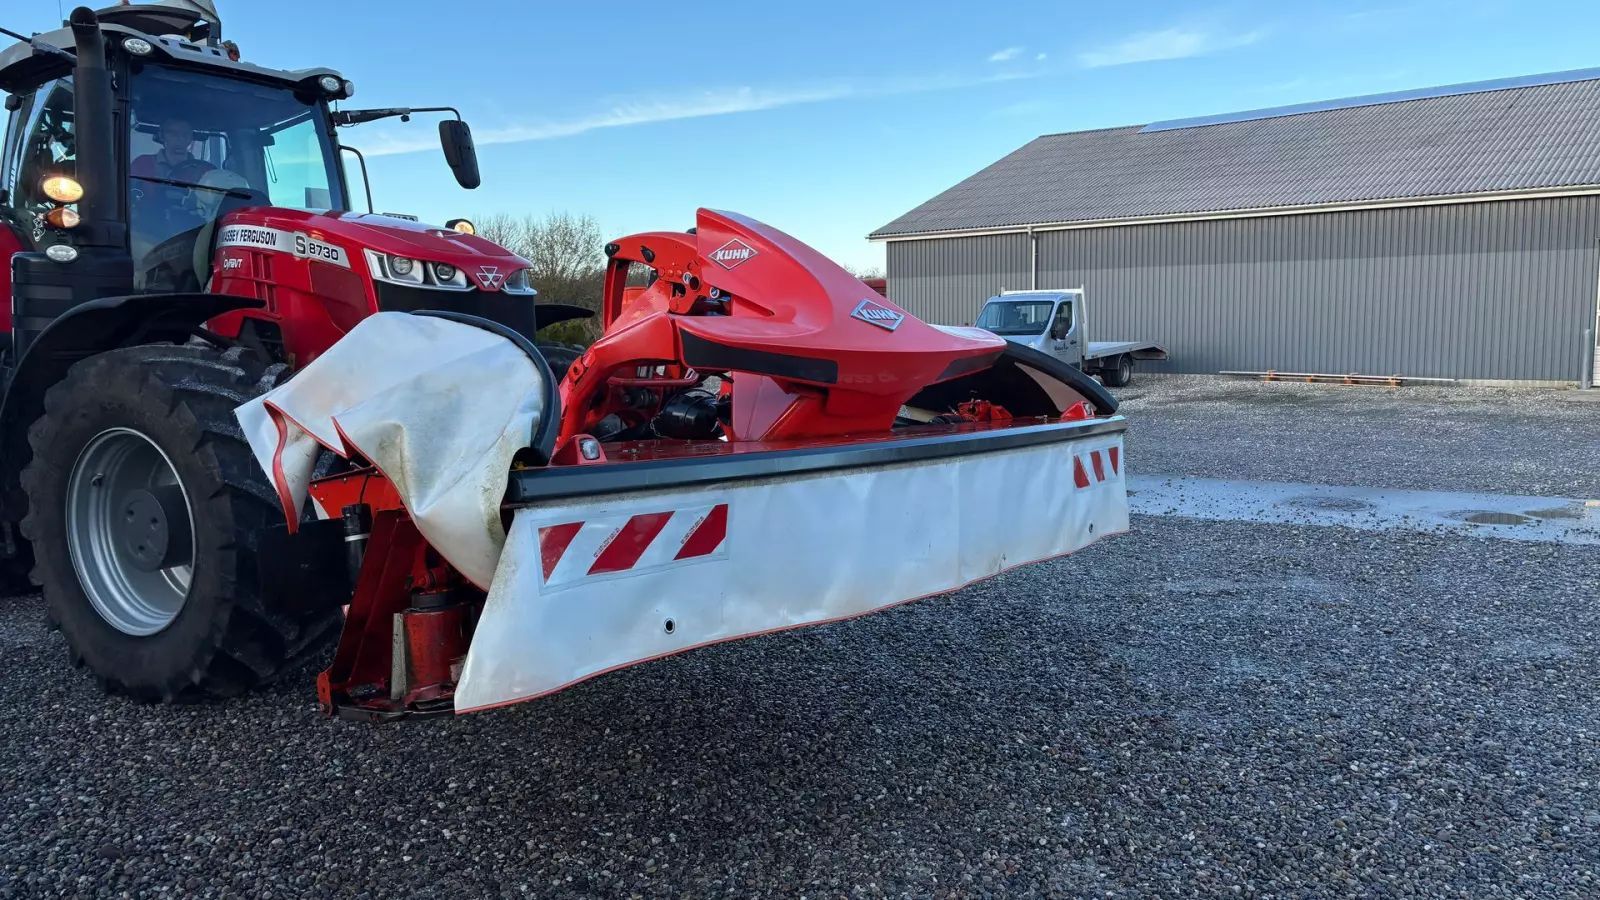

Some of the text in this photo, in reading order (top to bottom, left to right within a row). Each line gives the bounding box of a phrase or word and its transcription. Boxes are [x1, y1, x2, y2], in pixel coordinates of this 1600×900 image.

[239, 230, 277, 247] FERGUSON
[309, 243, 339, 261] 8730
[716, 248, 750, 261] KUHN
[860, 306, 898, 320] KUHN
